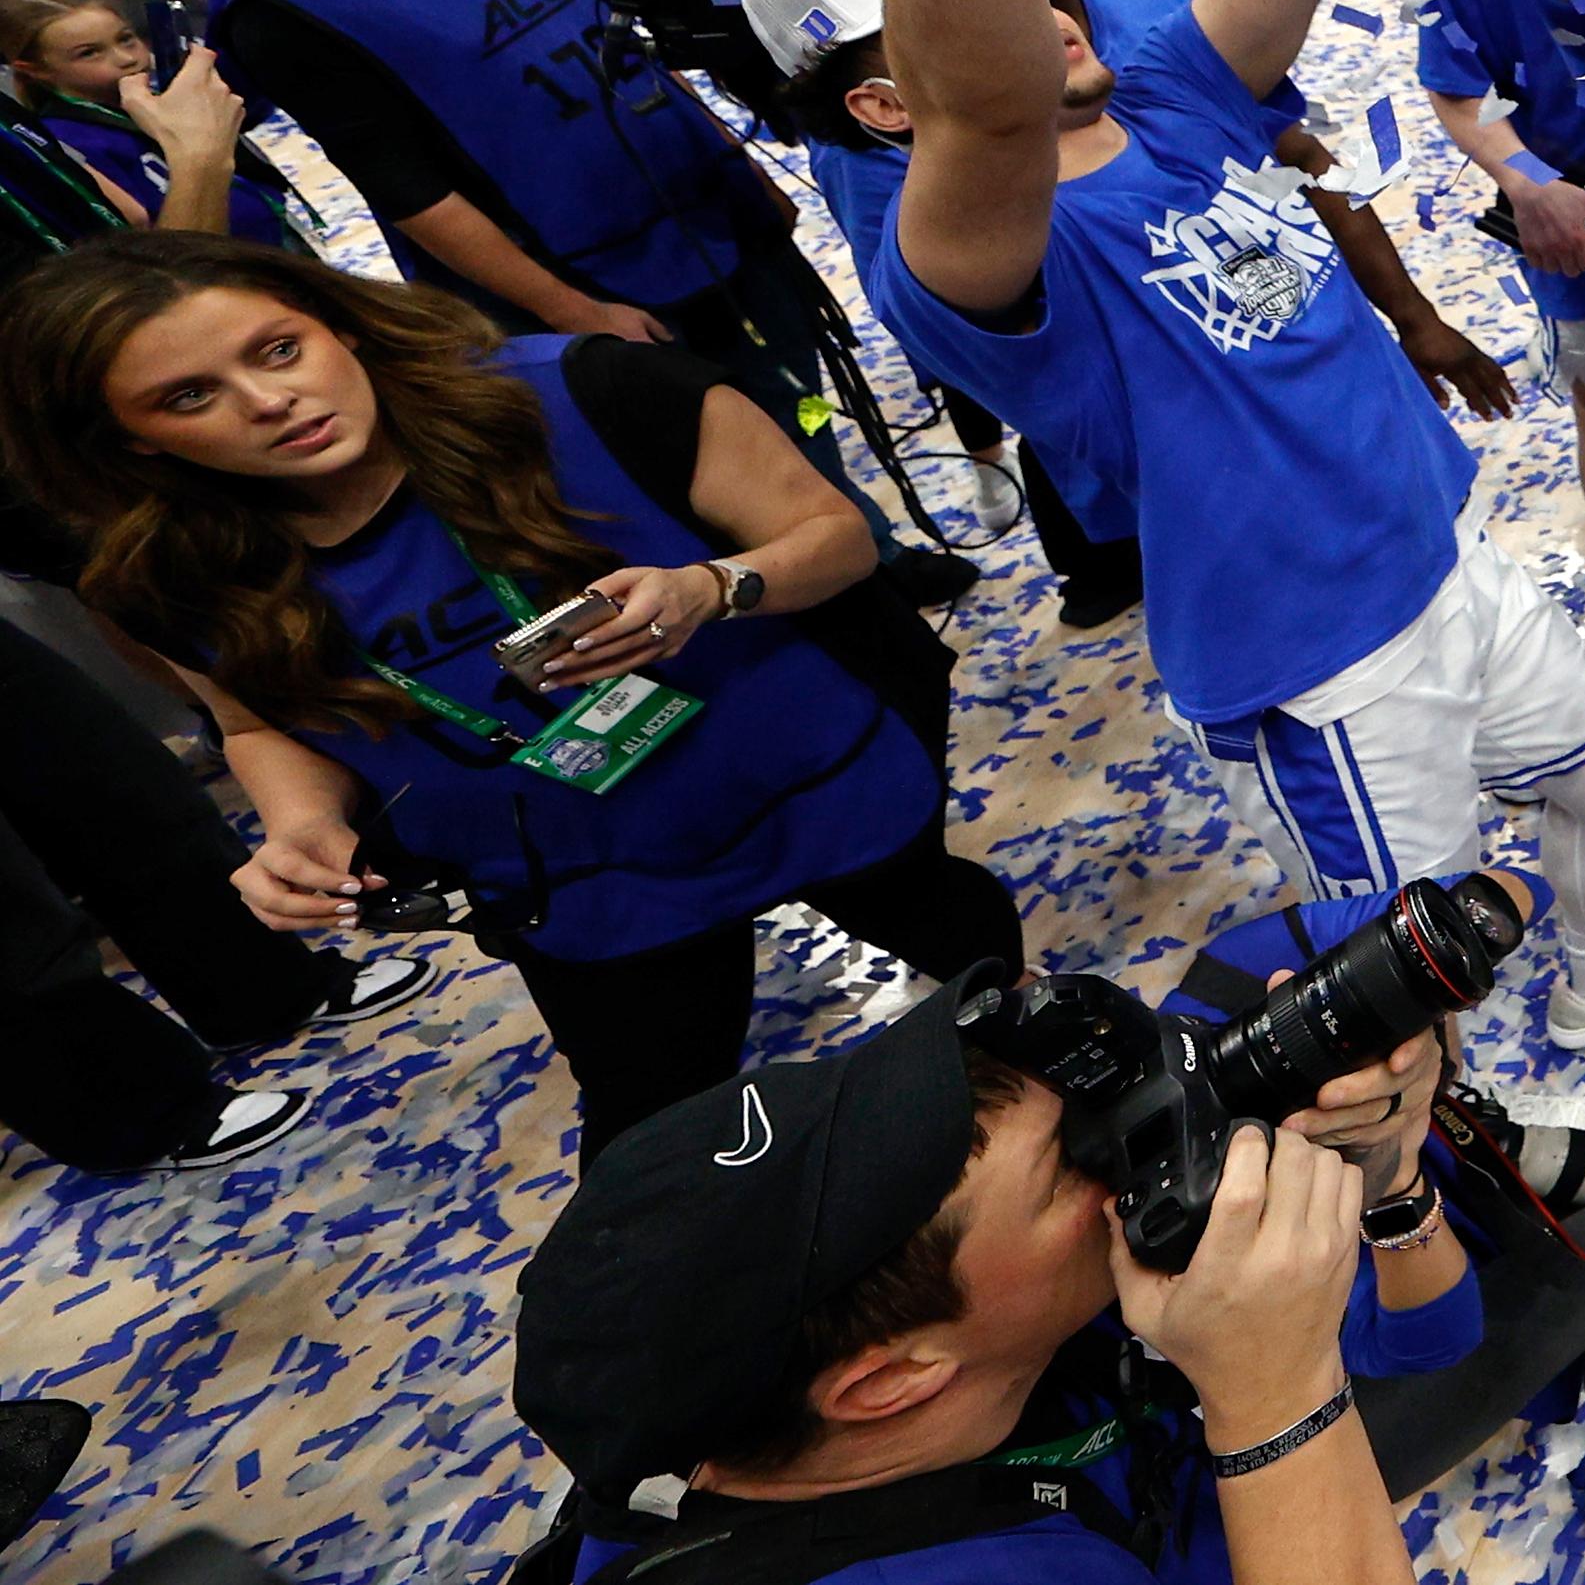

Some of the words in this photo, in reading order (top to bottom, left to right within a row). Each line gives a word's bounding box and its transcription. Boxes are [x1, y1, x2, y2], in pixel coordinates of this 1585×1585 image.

[367, 661, 418, 690] ACC
[620, 736, 652, 756] ALL
[640, 697, 690, 738] ACCESS
[1180, 1031, 1198, 1074] Canon
[1433, 1103, 1475, 1146] Canon
[1072, 1419, 1117, 1459] ACC
